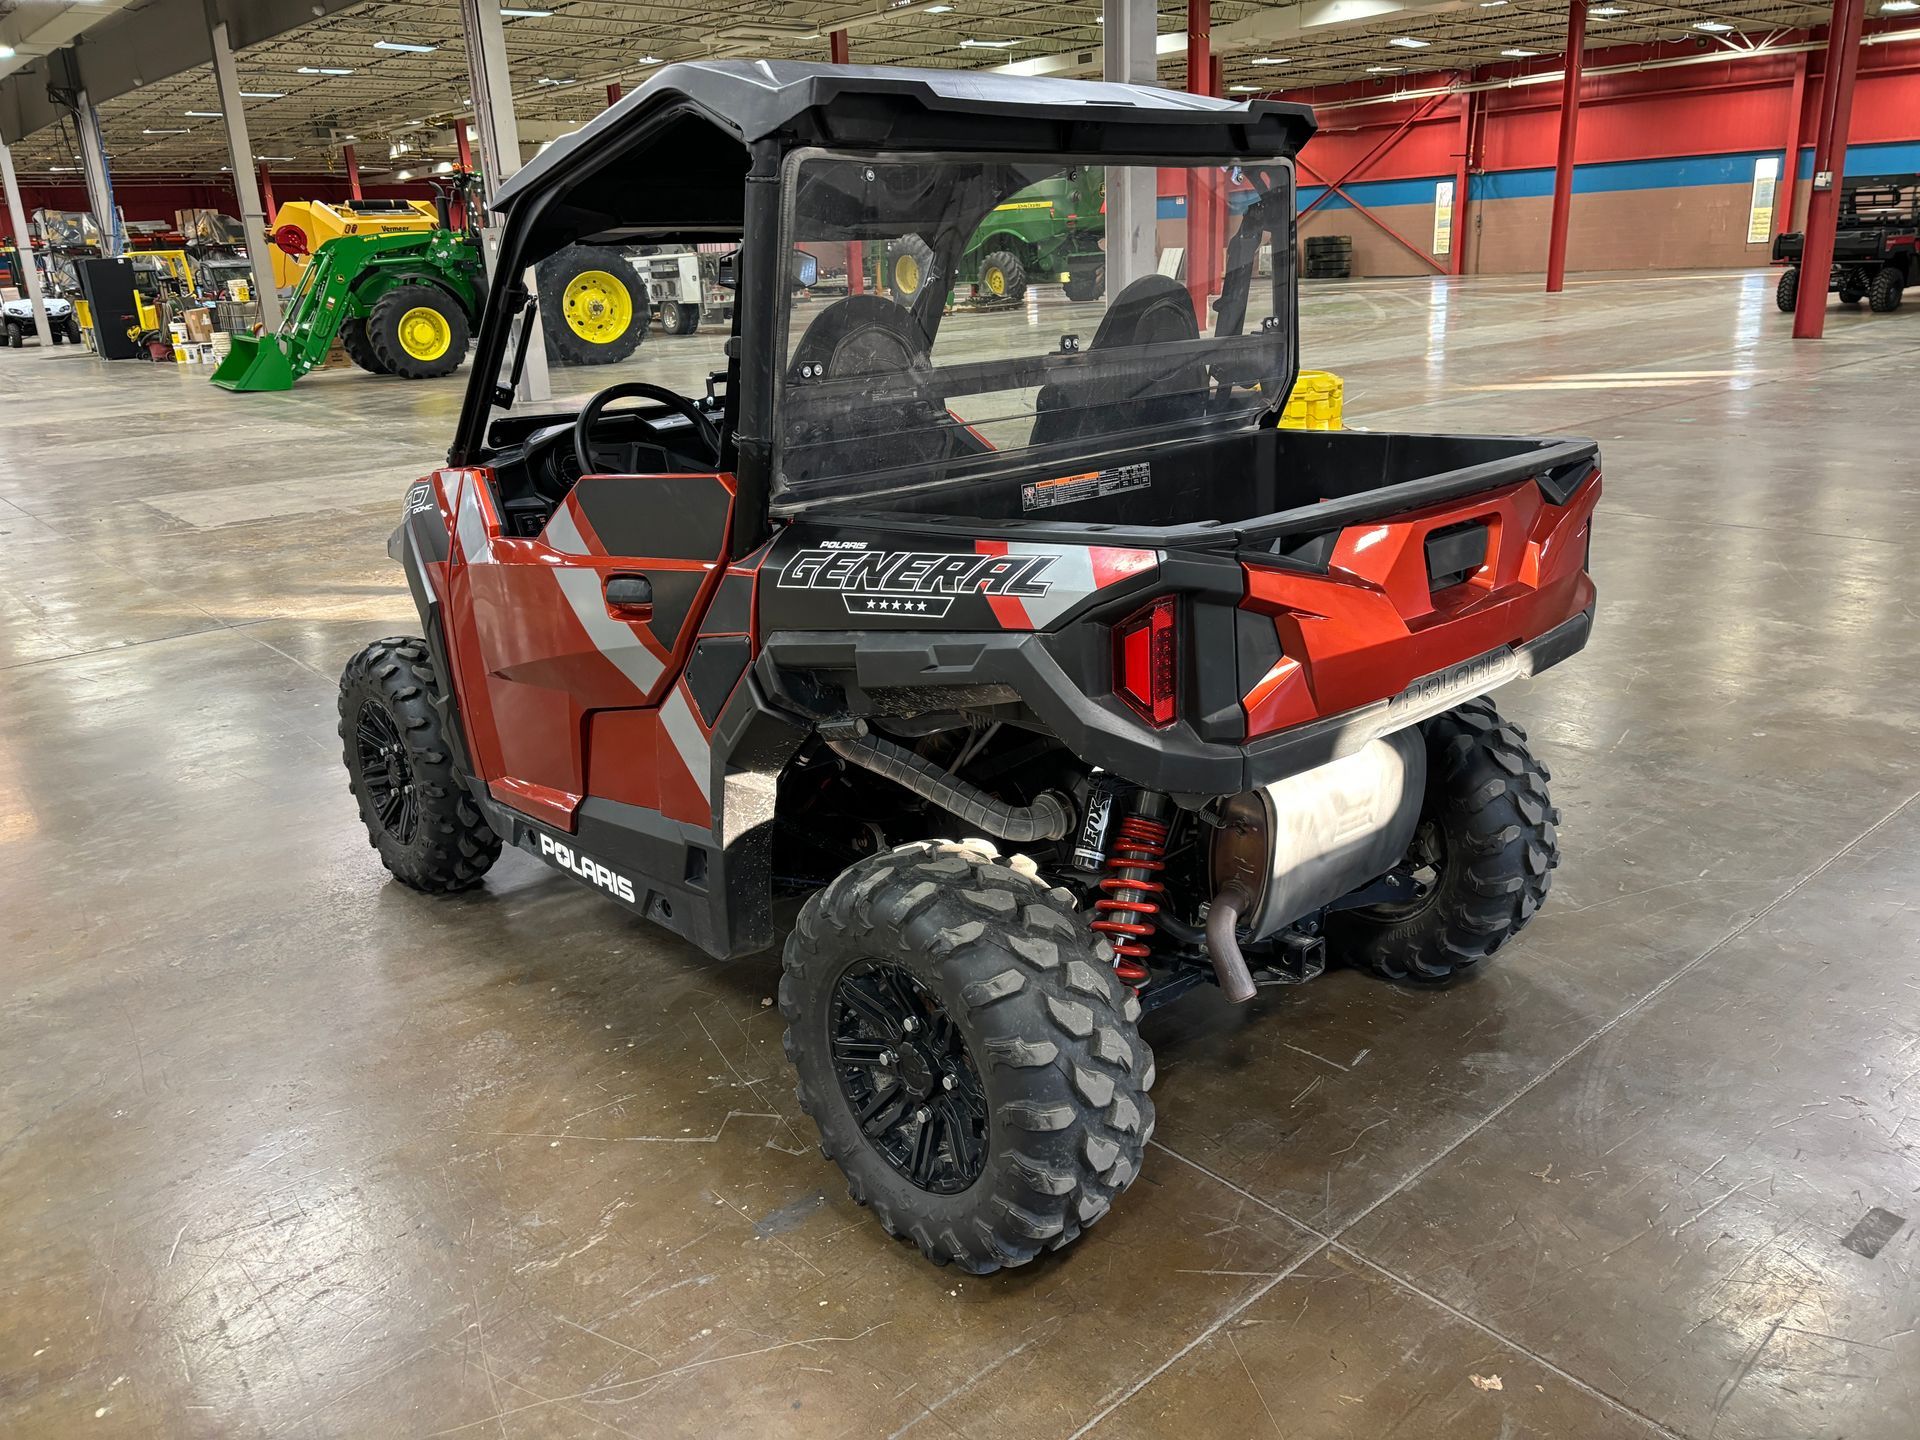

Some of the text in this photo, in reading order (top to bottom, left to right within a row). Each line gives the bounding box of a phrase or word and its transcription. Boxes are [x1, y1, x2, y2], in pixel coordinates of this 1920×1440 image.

[819, 540, 869, 550] POLARIS
[776, 549, 1062, 598] GENERAL
[1403, 650, 1506, 710] POLARIS
[1082, 796, 1109, 847] FOX
[540, 832, 636, 904] POLARIS
